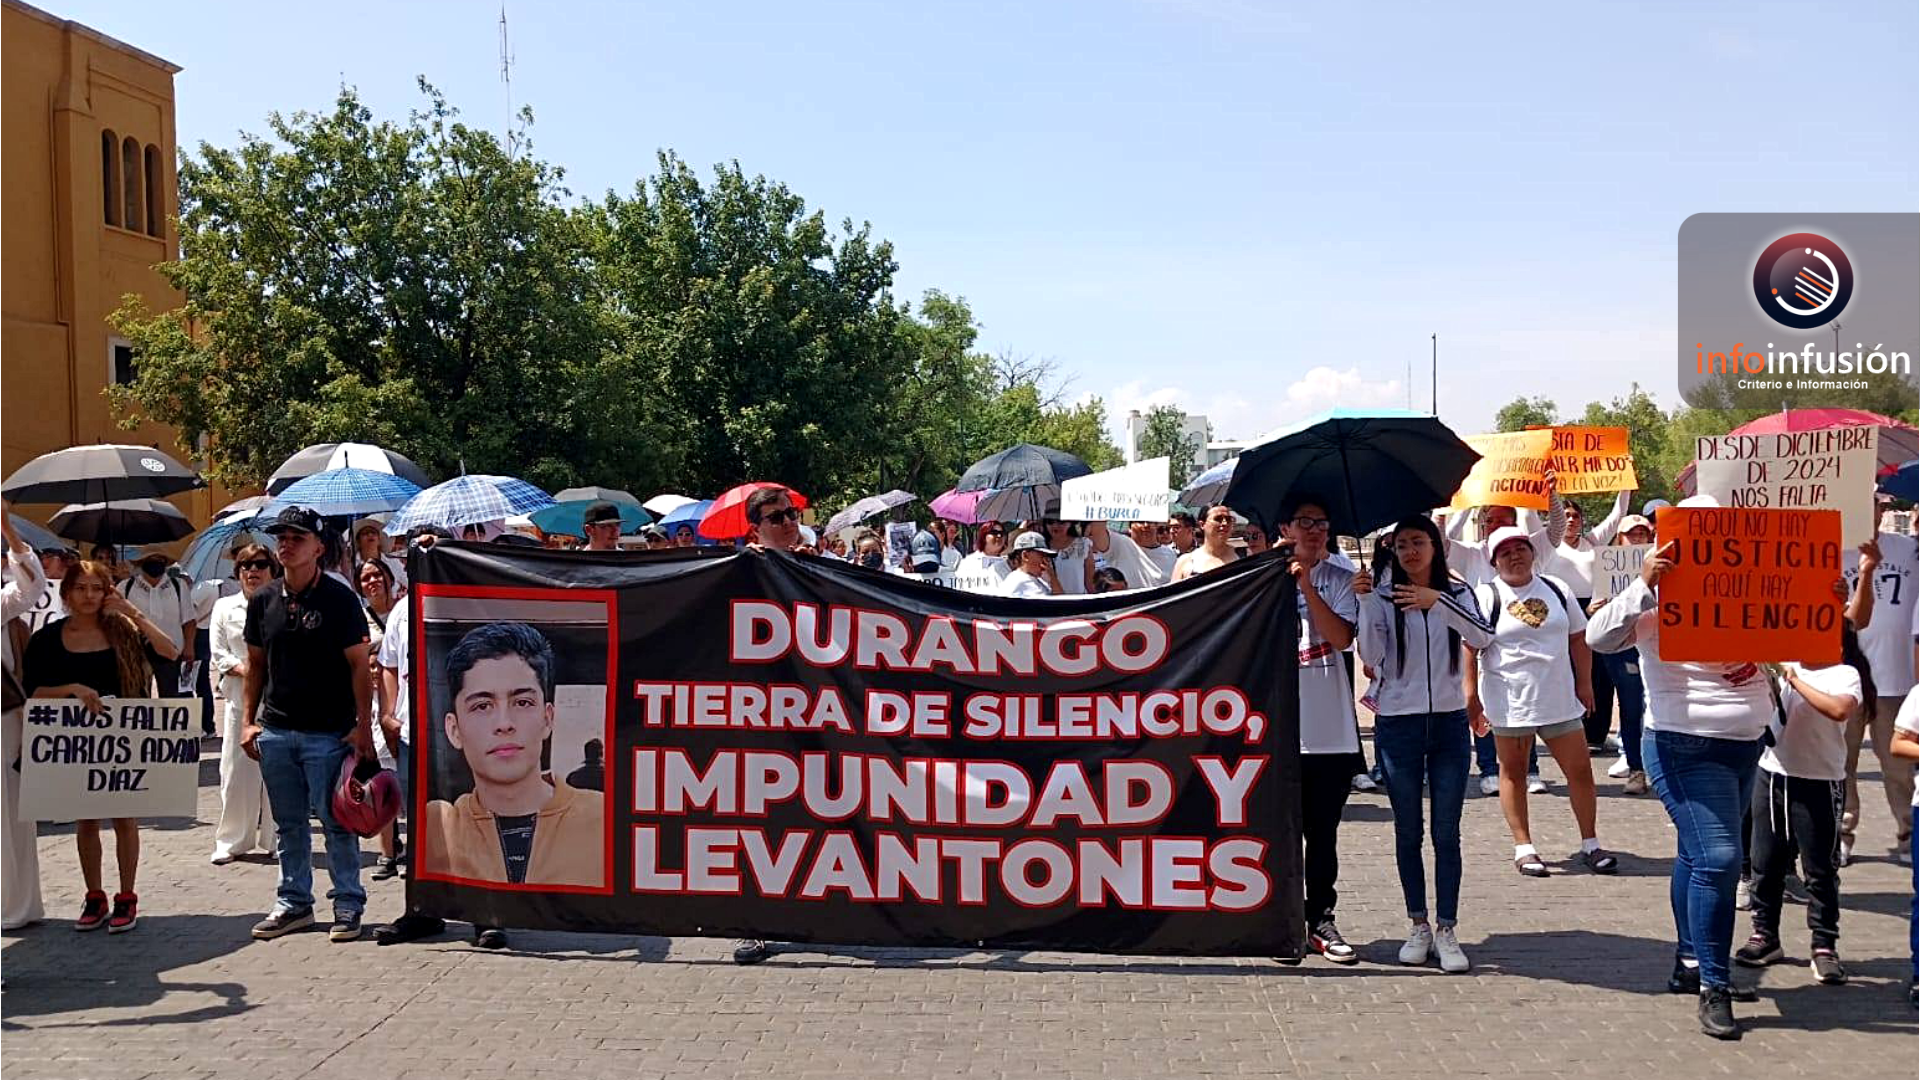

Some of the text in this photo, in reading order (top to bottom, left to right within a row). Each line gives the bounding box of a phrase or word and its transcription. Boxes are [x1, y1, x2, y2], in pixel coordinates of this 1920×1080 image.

[1585, 433, 1607, 451] DE
[1698, 428, 1874, 460] DESDE DICIEMBRE
[1748, 456, 1840, 484] DE 2024
[1731, 484, 1826, 508] NOS FALTA
[1745, 511, 1768, 537] NO
[1779, 512, 1811, 538] HAY
[1602, 549, 1626, 571] SU
[1672, 538, 1839, 570] JUSTICIA
[1761, 573, 1792, 600] HAY
[1663, 602, 1835, 632] SILENCIO
[730, 599, 1170, 677] DURANGO
[120, 705, 189, 731] FALTA
[635, 680, 1267, 743] TIERRA DE SILENCIO,
[31, 734, 132, 764] CARLOS
[87, 765, 149, 792] DÍAZ
[632, 746, 1271, 829] IMPUNIDAD Y
[631, 822, 1273, 912] LEVANTONES
